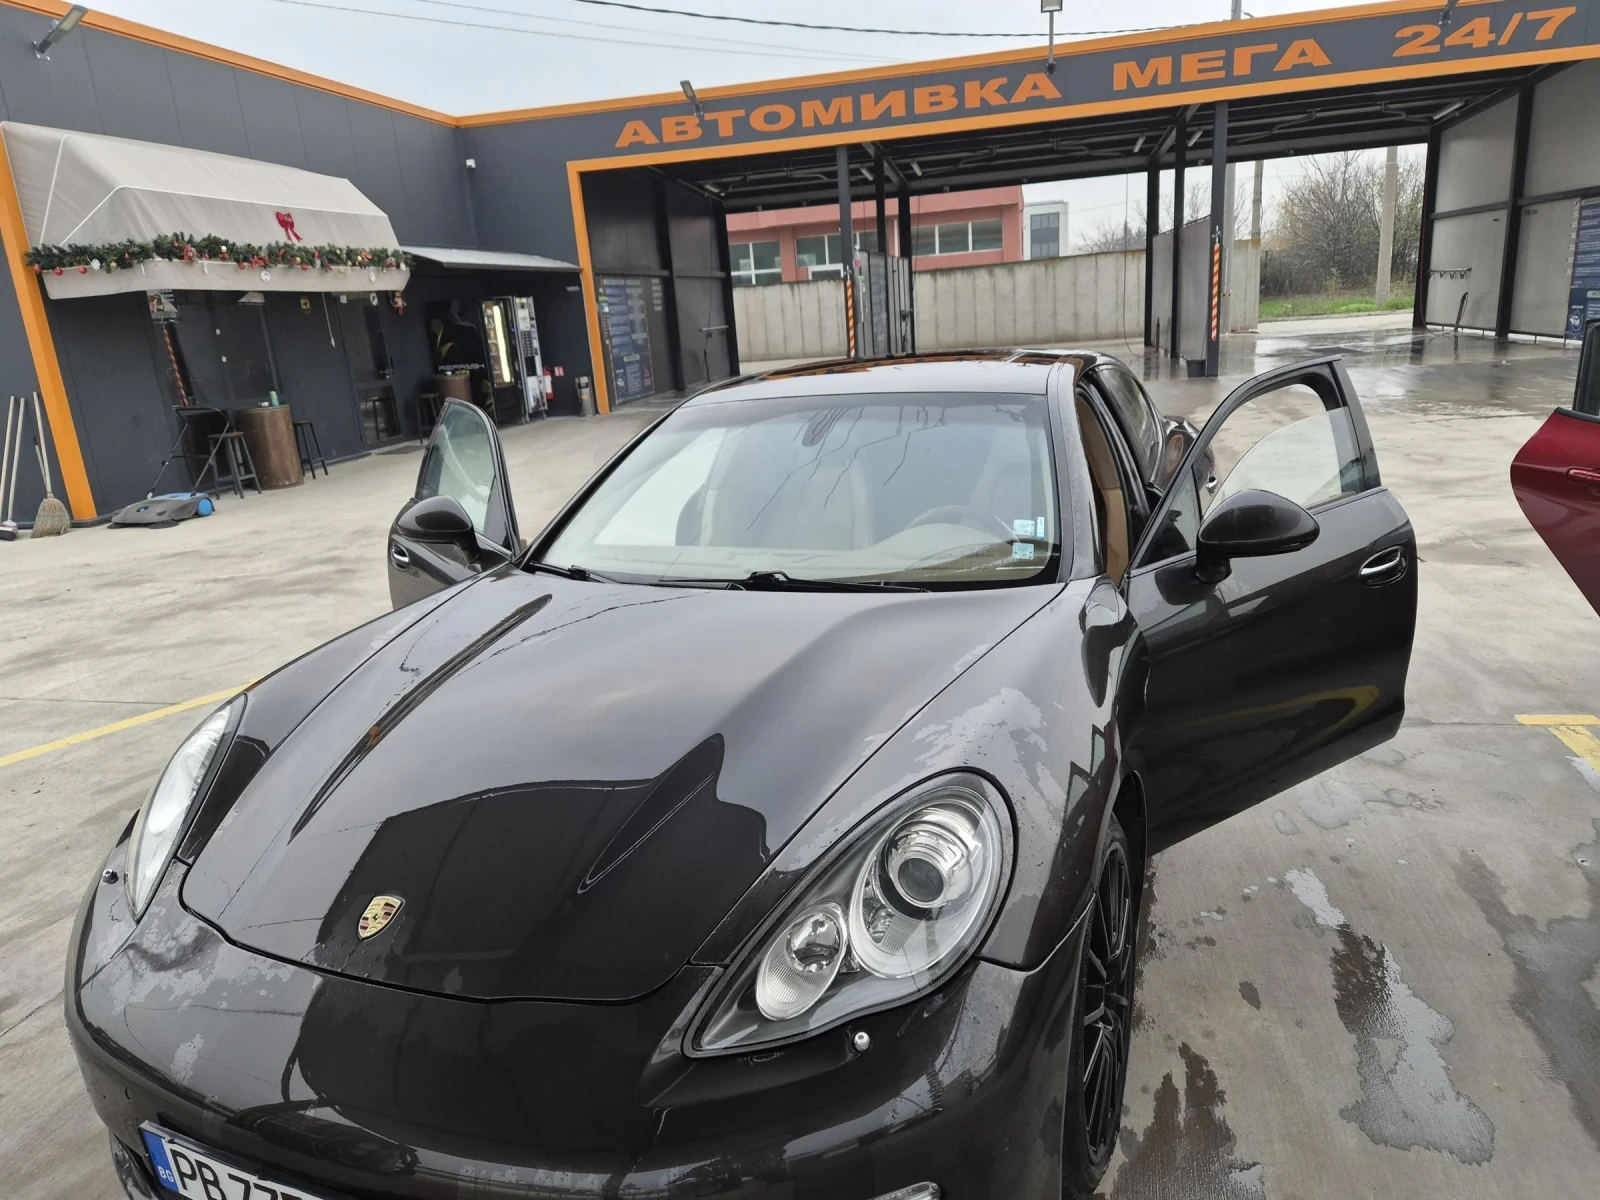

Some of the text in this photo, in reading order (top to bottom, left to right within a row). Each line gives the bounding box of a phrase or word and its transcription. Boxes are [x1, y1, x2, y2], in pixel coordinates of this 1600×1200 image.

[615, 6, 1577, 148] АВТОМИВКА МЕГА 24/7
[157, 1166, 175, 1183] BG
